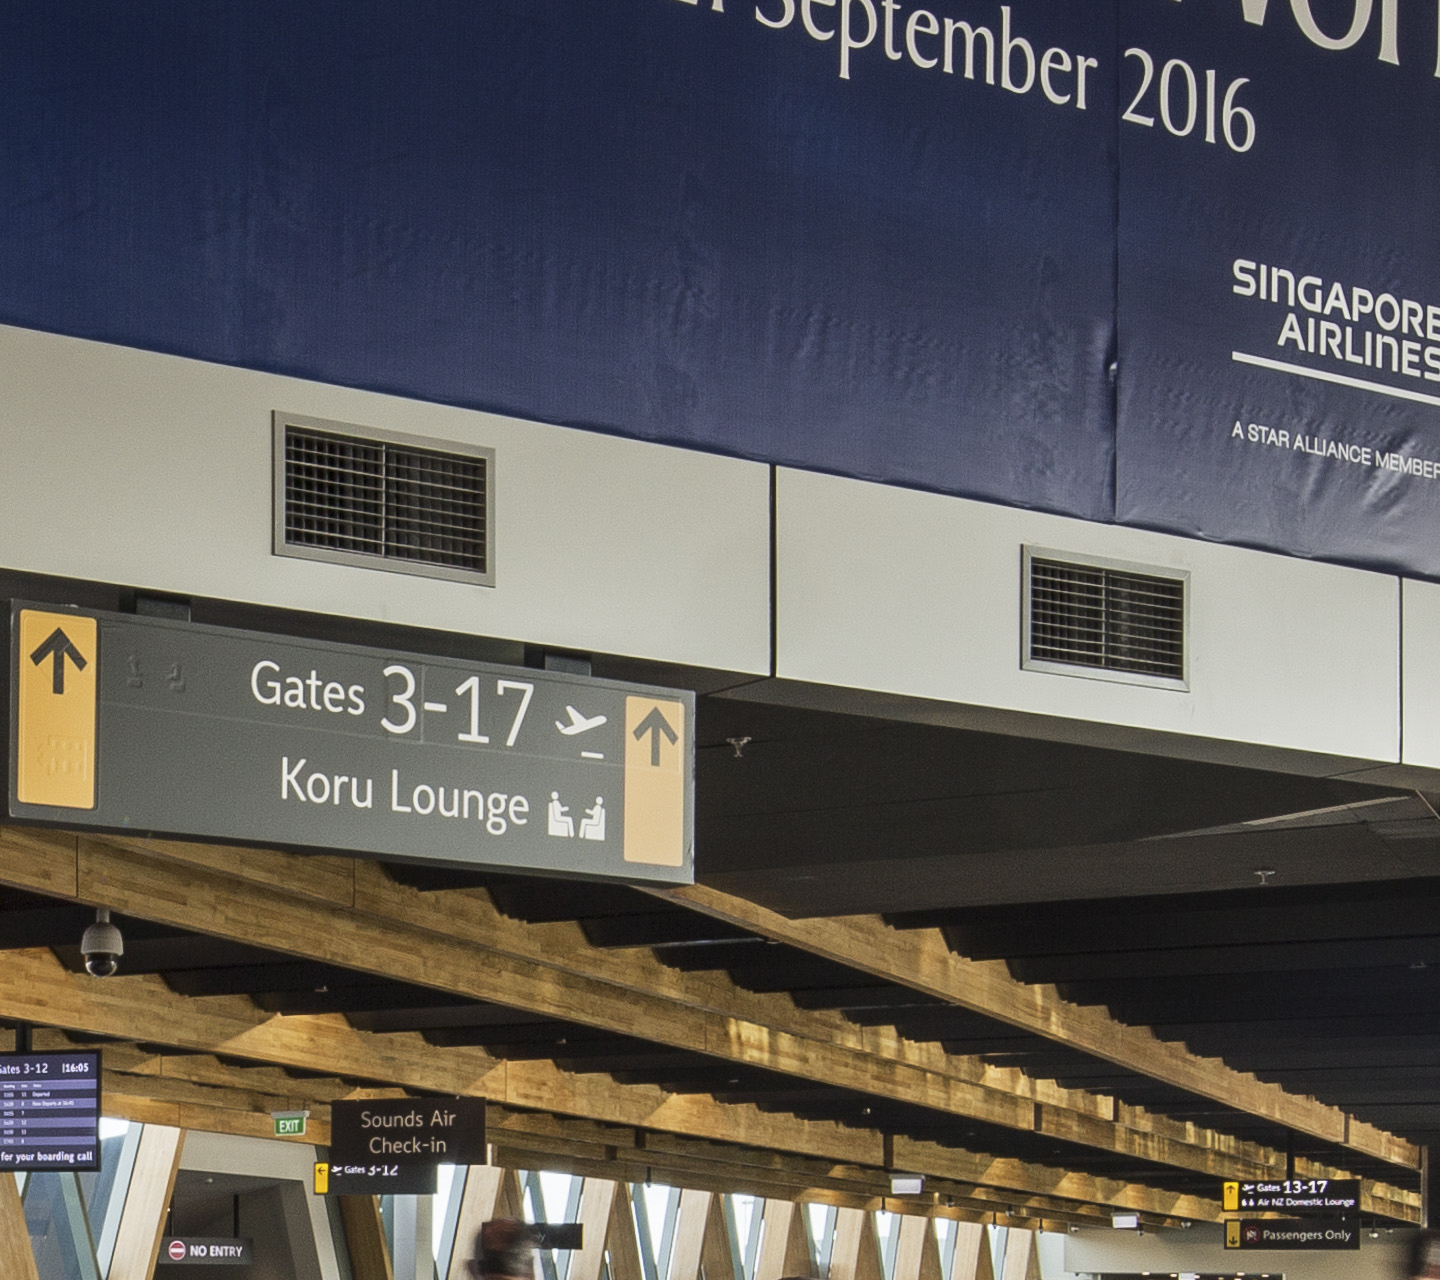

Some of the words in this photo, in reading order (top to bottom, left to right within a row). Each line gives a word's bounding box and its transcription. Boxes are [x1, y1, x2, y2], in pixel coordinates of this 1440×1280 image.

[1122, 47, 1258, 154] 2016
[1231, 421, 1245, 439] A
[1247, 423, 1290, 450] STAR
[1293, 432, 1372, 466] ALLIANCE
[250, 659, 366, 716] Gates
[380, 664, 535, 747] 3-17
[280, 756, 374, 810] Koru
[391, 768, 530, 836] Lounge
[23, 1062, 48, 1074] 3-12
[279, 1119, 300, 1133] EXIT
[360, 1110, 424, 1129] Sounds
[430, 1109, 457, 1127] Air
[369, 1136, 447, 1154] Check-in
[0, 1151, 14, 1162] for
[15, 1153, 34, 1164] your
[37, 1151, 74, 1164] boarding
[77, 1150, 93, 1162] call
[344, 1165, 366, 1175] Gates
[367, 1164, 399, 1176] 3-12
[1256, 1183, 1281, 1192] Gates
[1282, 1180, 1328, 1194] 13-17
[1257, 1198, 1270, 1206] Air
[1271, 1198, 1284, 1206] NZ
[1285, 1198, 1323, 1206] Domestic
[1325, 1198, 1355, 1207] Lounge
[1263, 1230, 1323, 1242] Passengers
[1325, 1230, 1352, 1242] Only
[189, 1244, 207, 1257] NO
[210, 1245, 243, 1258] ENTRY
